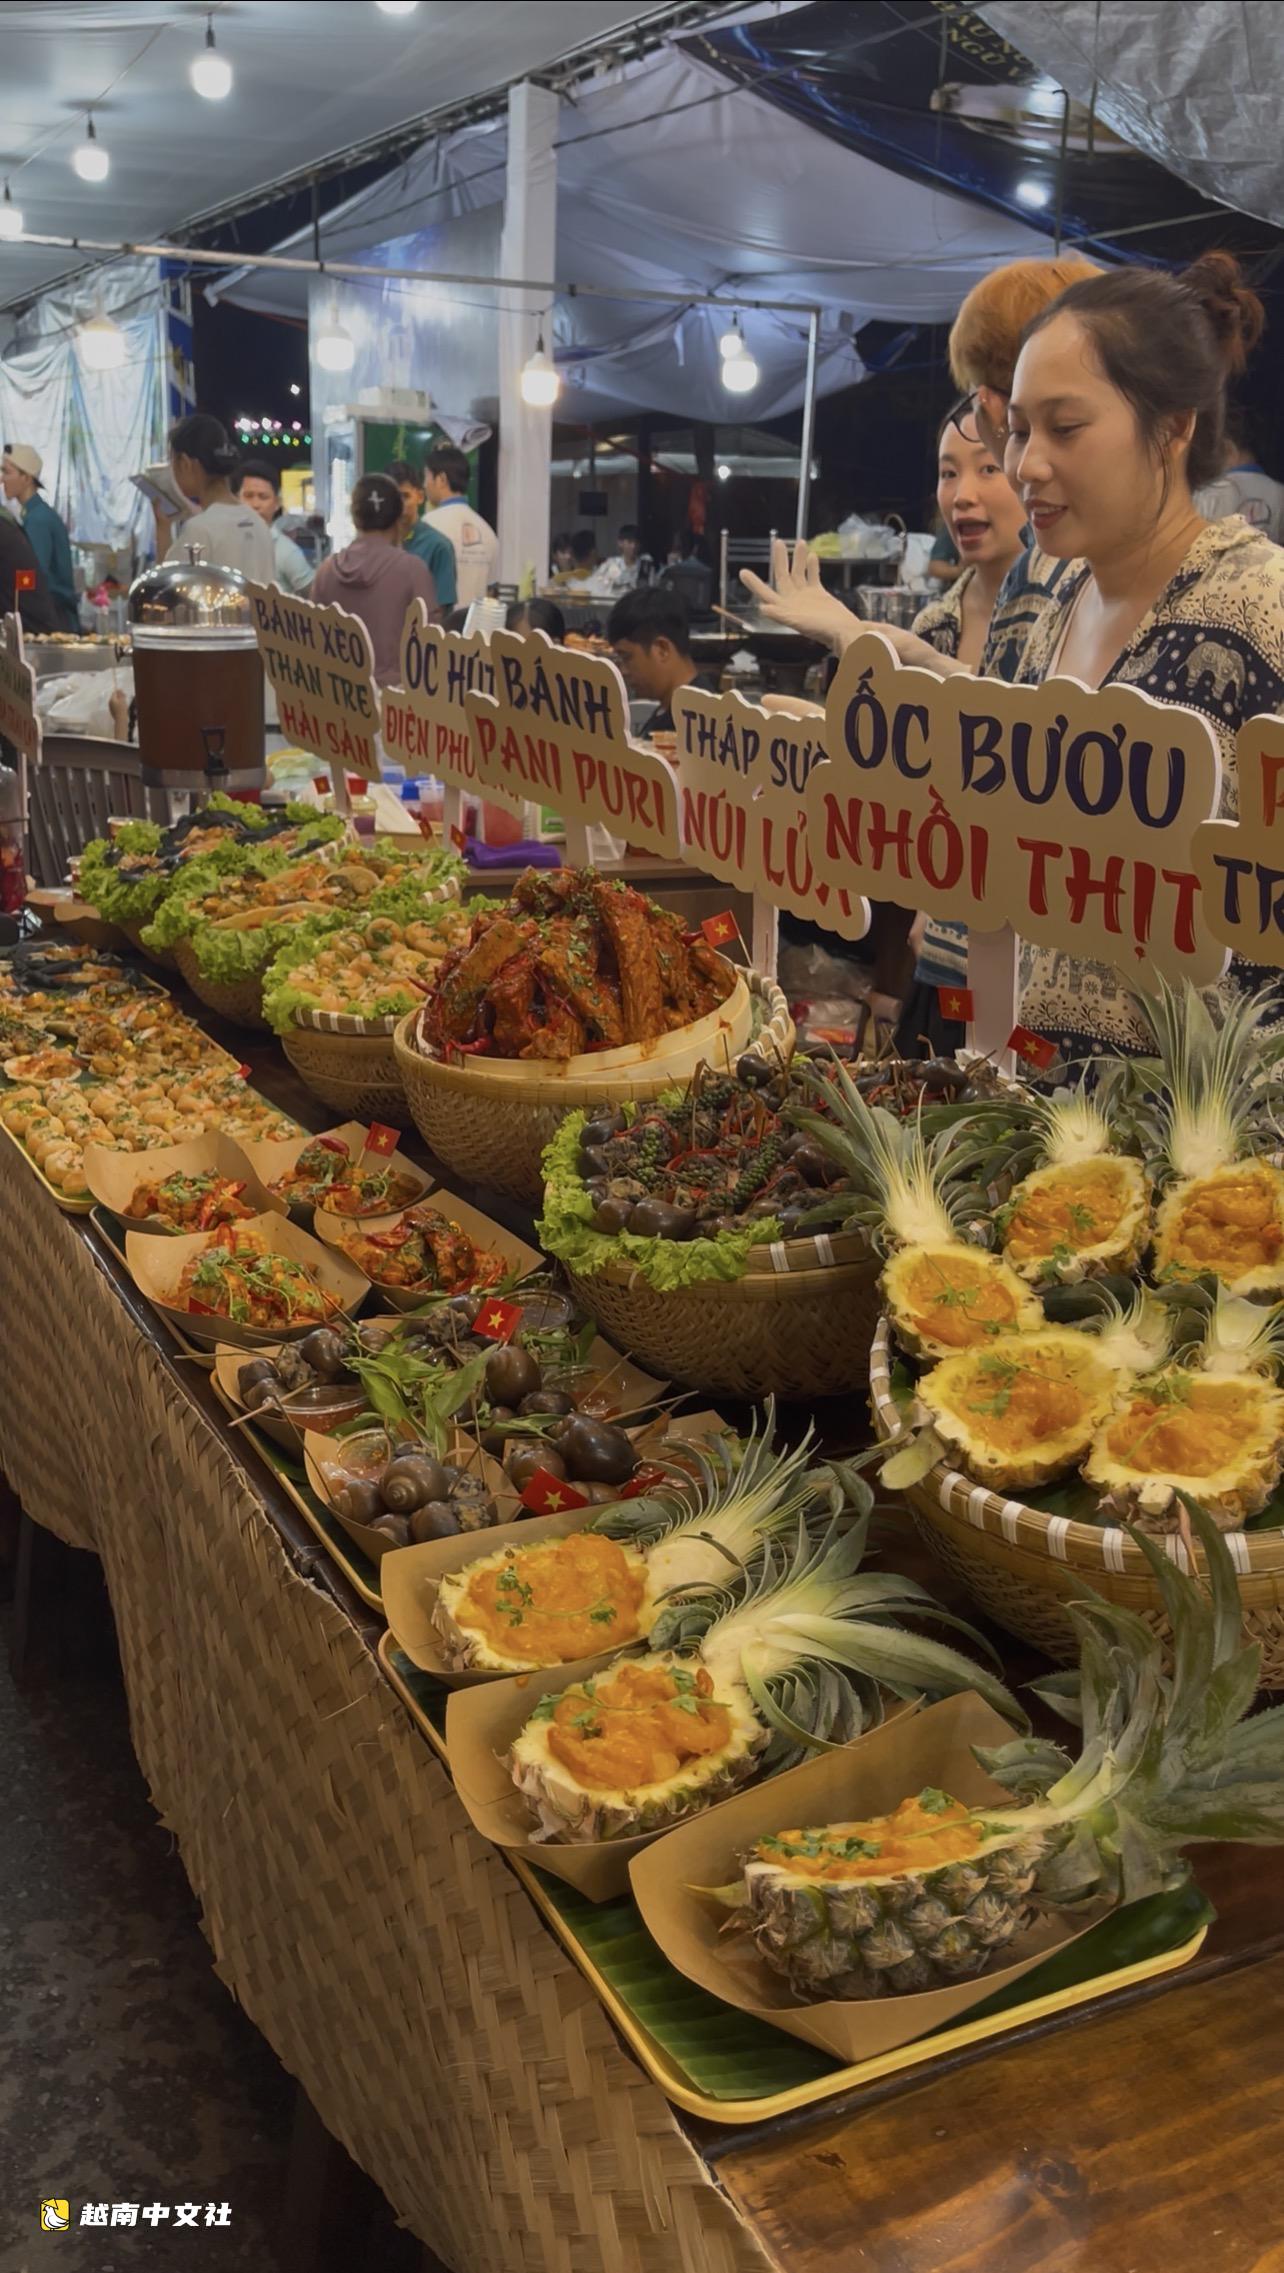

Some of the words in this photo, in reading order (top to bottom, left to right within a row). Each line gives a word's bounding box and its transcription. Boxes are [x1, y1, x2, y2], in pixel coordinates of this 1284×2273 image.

[254, 598, 316, 649] BÁNH
[319, 621, 365, 668] XÈO
[406, 617, 439, 697] ỐC
[264, 647, 324, 698] THAN
[326, 672, 372, 719] TRE
[501, 655, 614, 740] BÁNH
[386, 704, 430, 760] ĐIỆN
[681, 709, 760, 775] THÁP
[844, 666, 932, 779] ỐC
[959, 710, 1186, 829] BƯƠU
[475, 715, 563, 795] PANI
[572, 750, 665, 837] PURI
[682, 787, 747, 871] NÚI
[823, 784, 989, 901] NHỒI
[1017, 837, 1202, 962] THỊT
